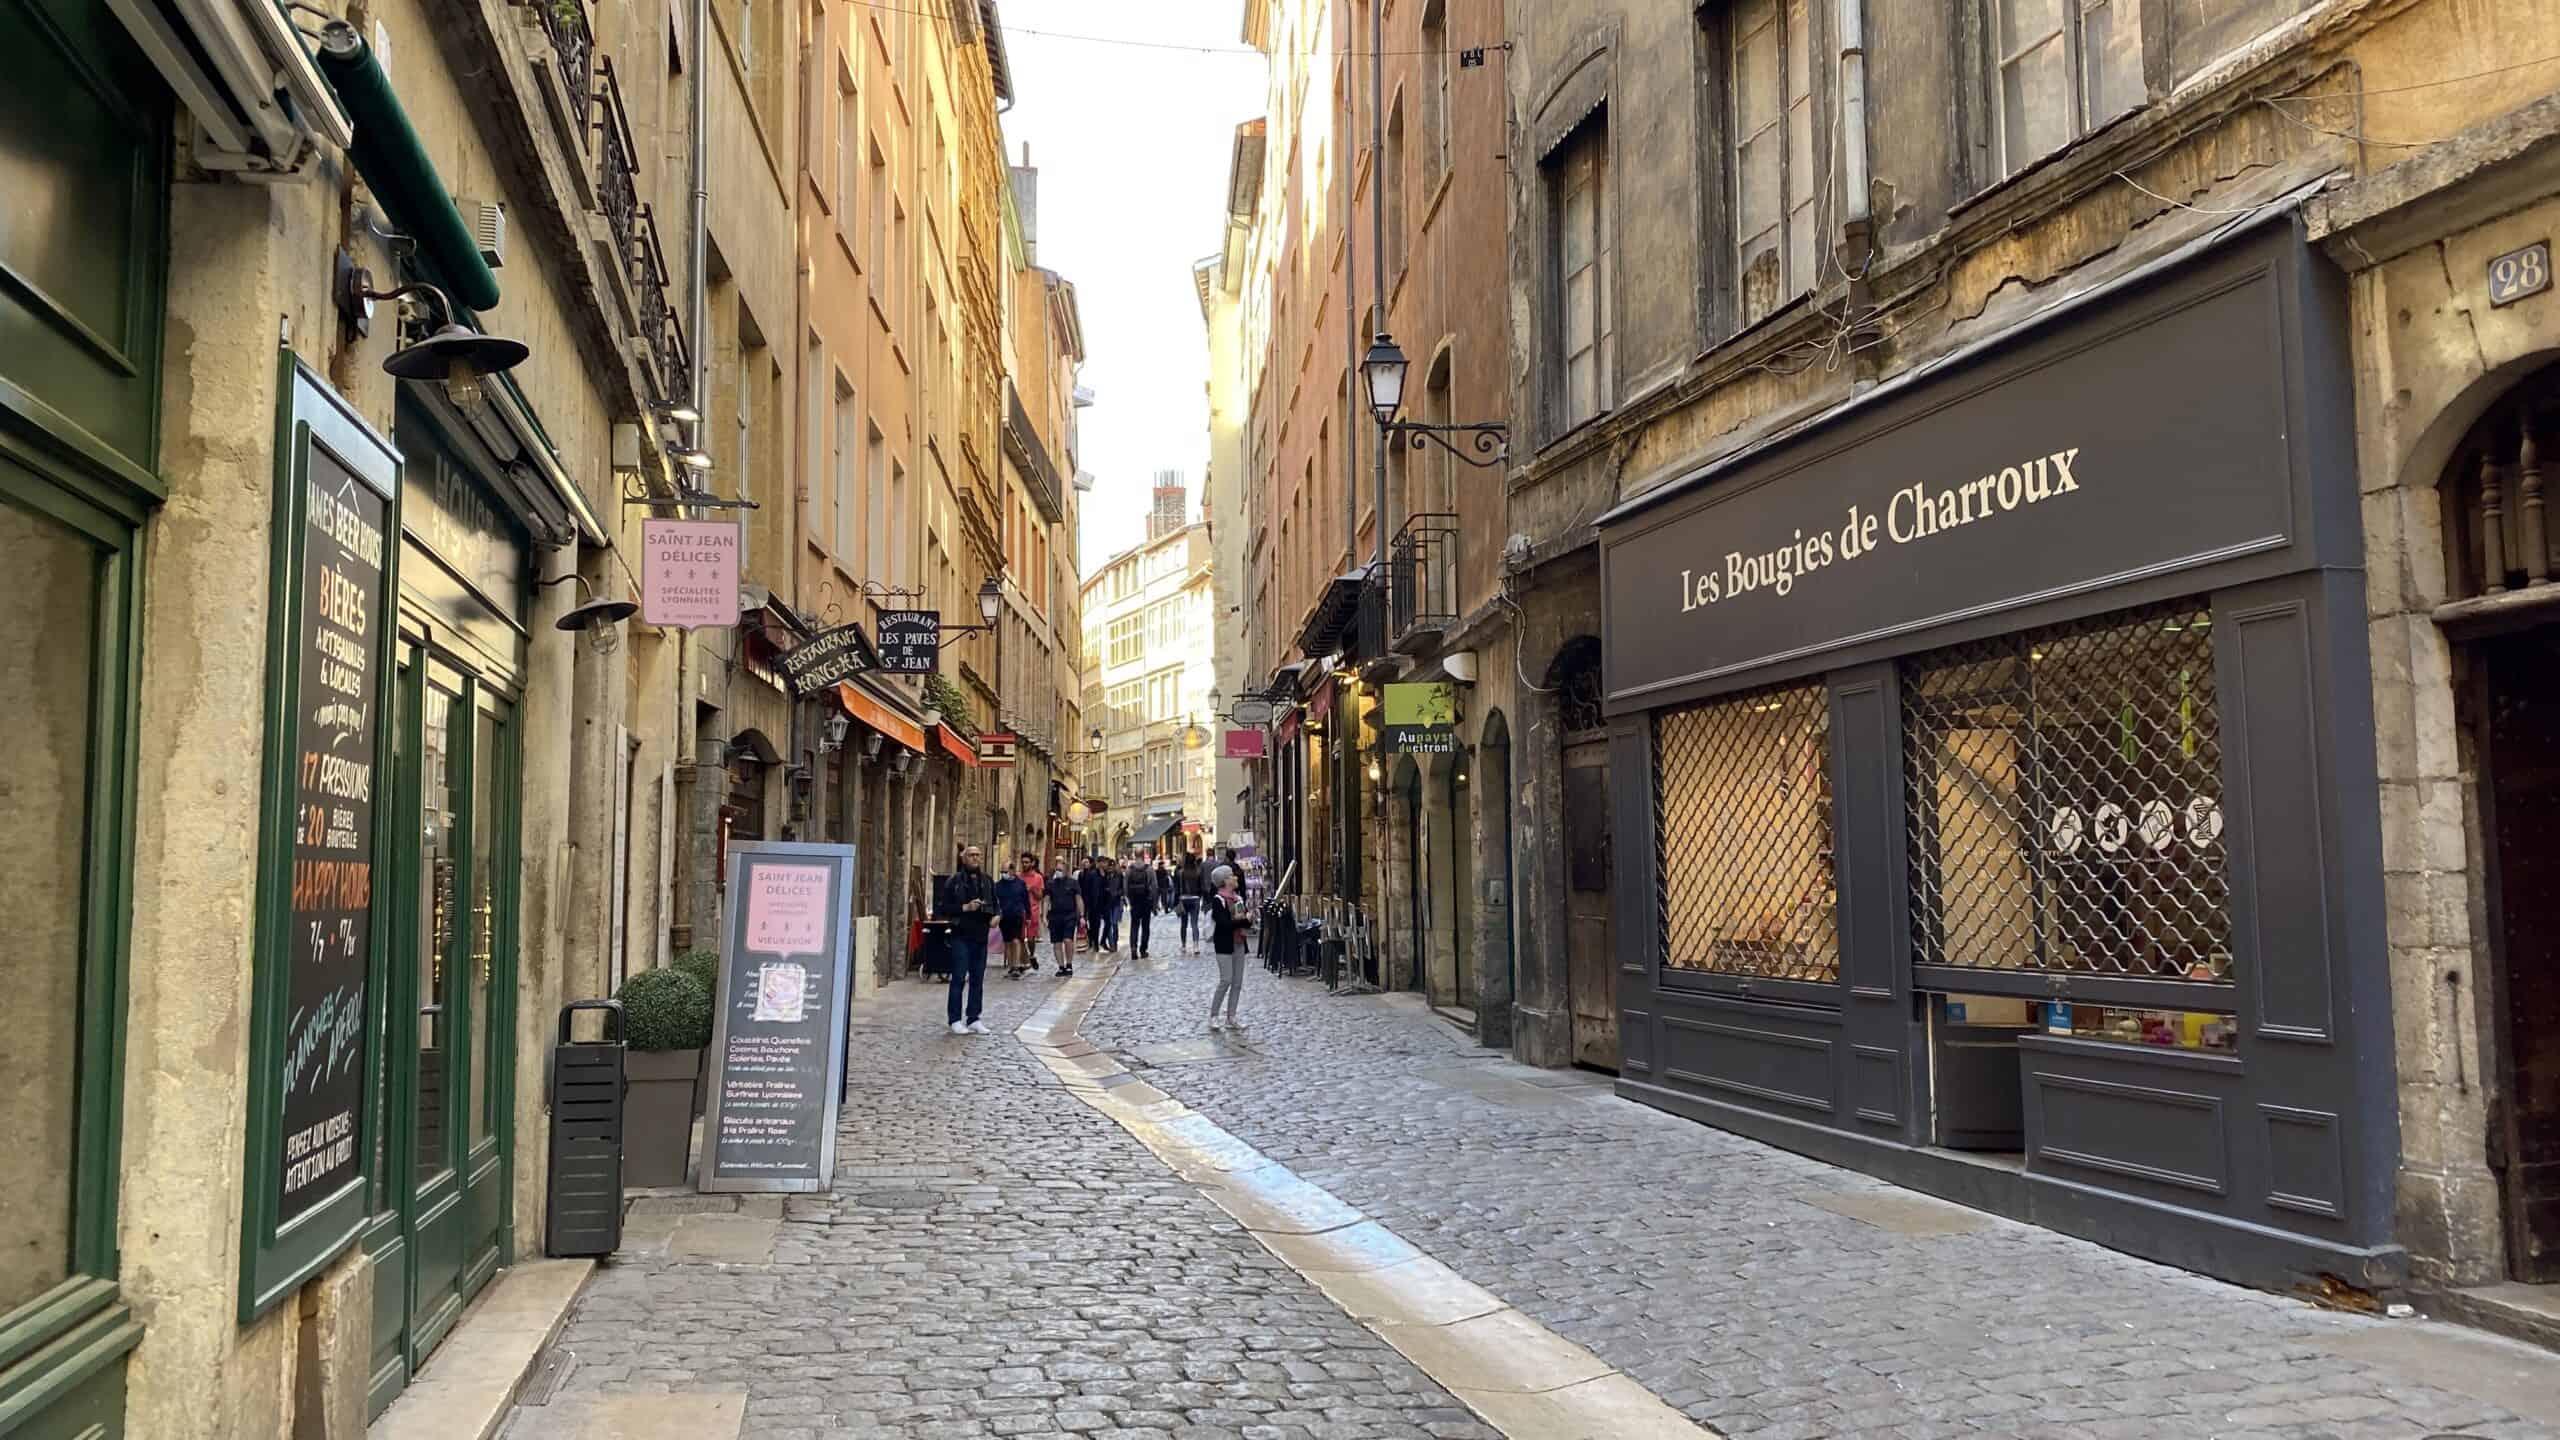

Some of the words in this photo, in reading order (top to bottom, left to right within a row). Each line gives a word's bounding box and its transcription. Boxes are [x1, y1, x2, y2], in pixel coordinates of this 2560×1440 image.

[2497, 251, 2542, 297] 28
[336, 501, 360, 555] BEER
[648, 534, 693, 545] SAINT
[696, 535, 734, 547] JEAN
[1681, 569, 1719, 612] Les
[1725, 529, 1833, 596] Bougies
[1840, 505, 1878, 561] de
[1887, 447, 2081, 543] Charroux
[661, 548, 720, 562] DÉLICES
[320, 563, 365, 636] BIÈRES
[879, 613, 938, 630] RESTAURANT
[880, 632, 899, 644] LES
[784, 630, 857, 675] RESTAURANT
[902, 646, 913, 655] DE
[902, 657, 930, 669] JEAN
[329, 661, 360, 698] LOCALES
[303, 751, 319, 791] 17
[319, 753, 369, 803] PRESSIONS
[306, 804, 325, 848] 20
[291, 859, 340, 912] HAPPY
[758, 872, 791, 882] SAINT
[794, 873, 823, 883] JEAN
[766, 883, 815, 896] DÉLICES
[286, 1127, 313, 1164] PENSEZ
[284, 1150, 326, 1195] ATTENTION
[326, 1146, 335, 1171] AU
